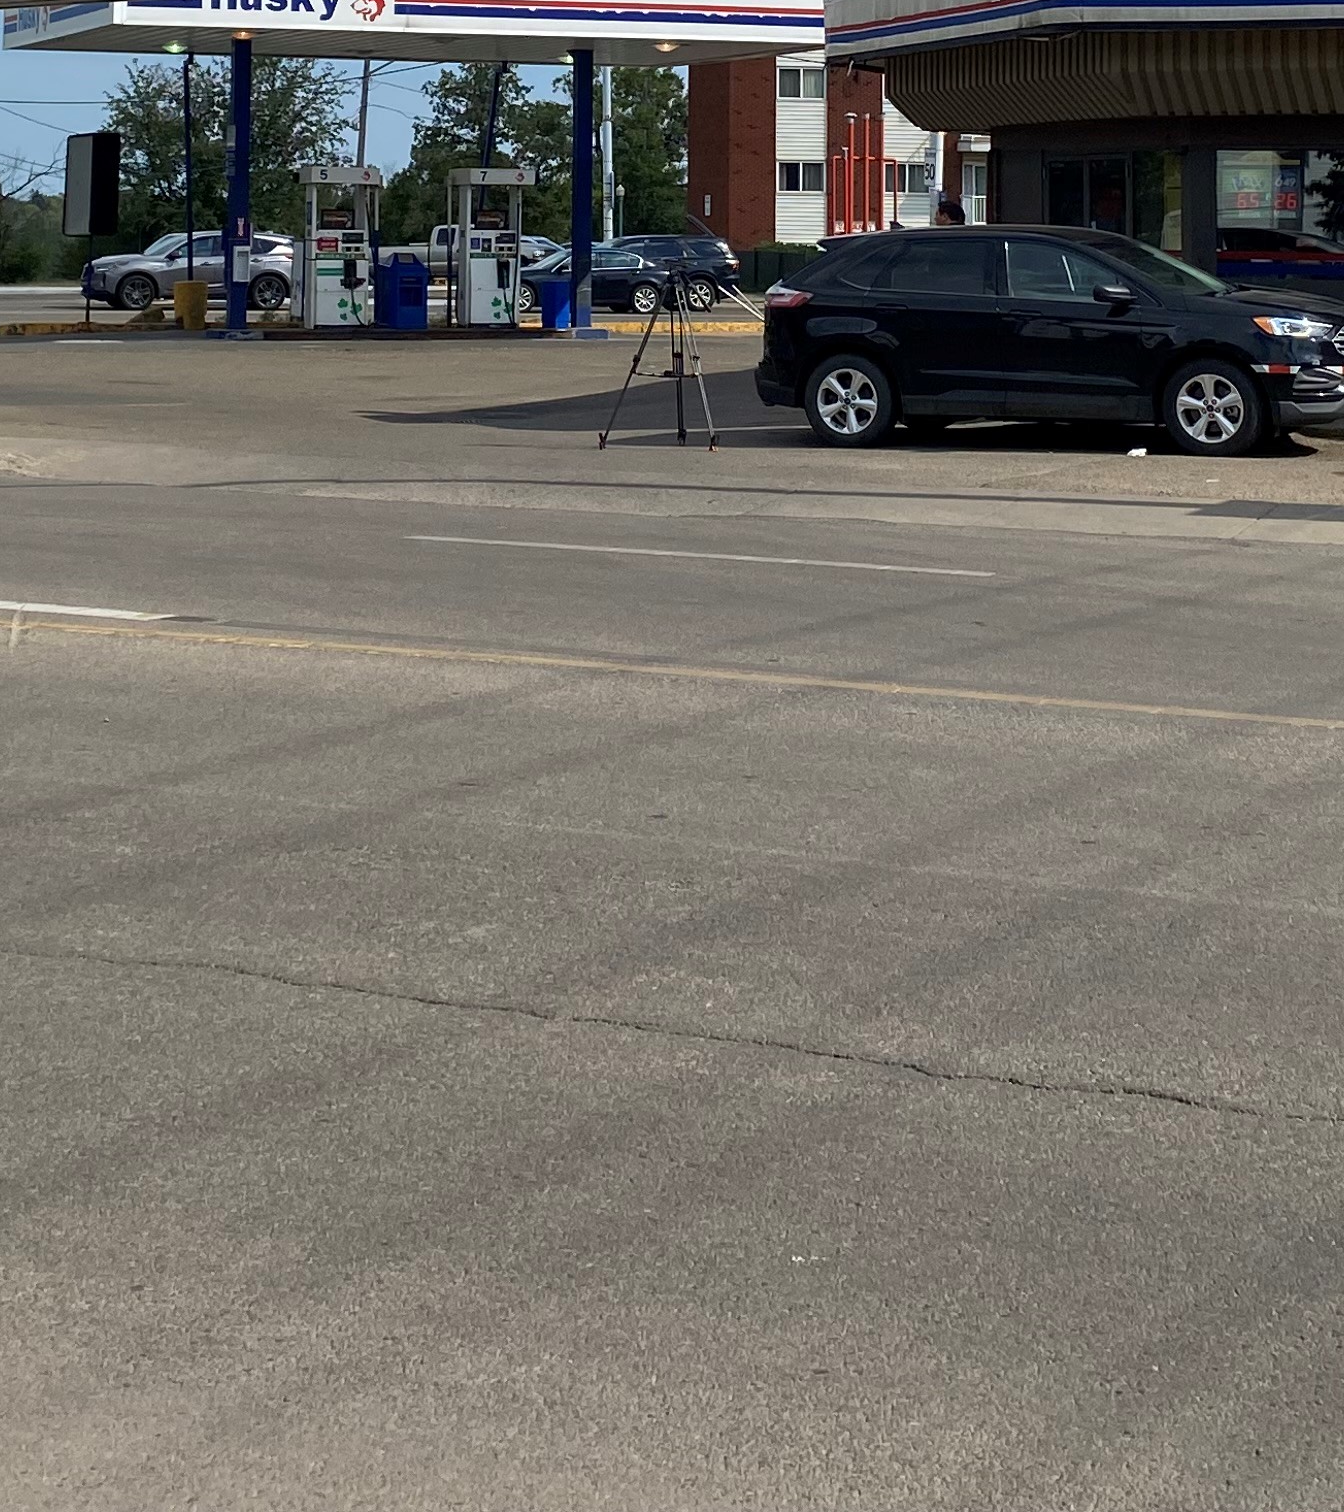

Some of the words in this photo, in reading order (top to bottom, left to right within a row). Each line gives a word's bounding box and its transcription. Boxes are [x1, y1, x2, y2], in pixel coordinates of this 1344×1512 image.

[319, 169, 329, 181] 5
[479, 170, 489, 182] 7
[925, 163, 936, 180] 50
